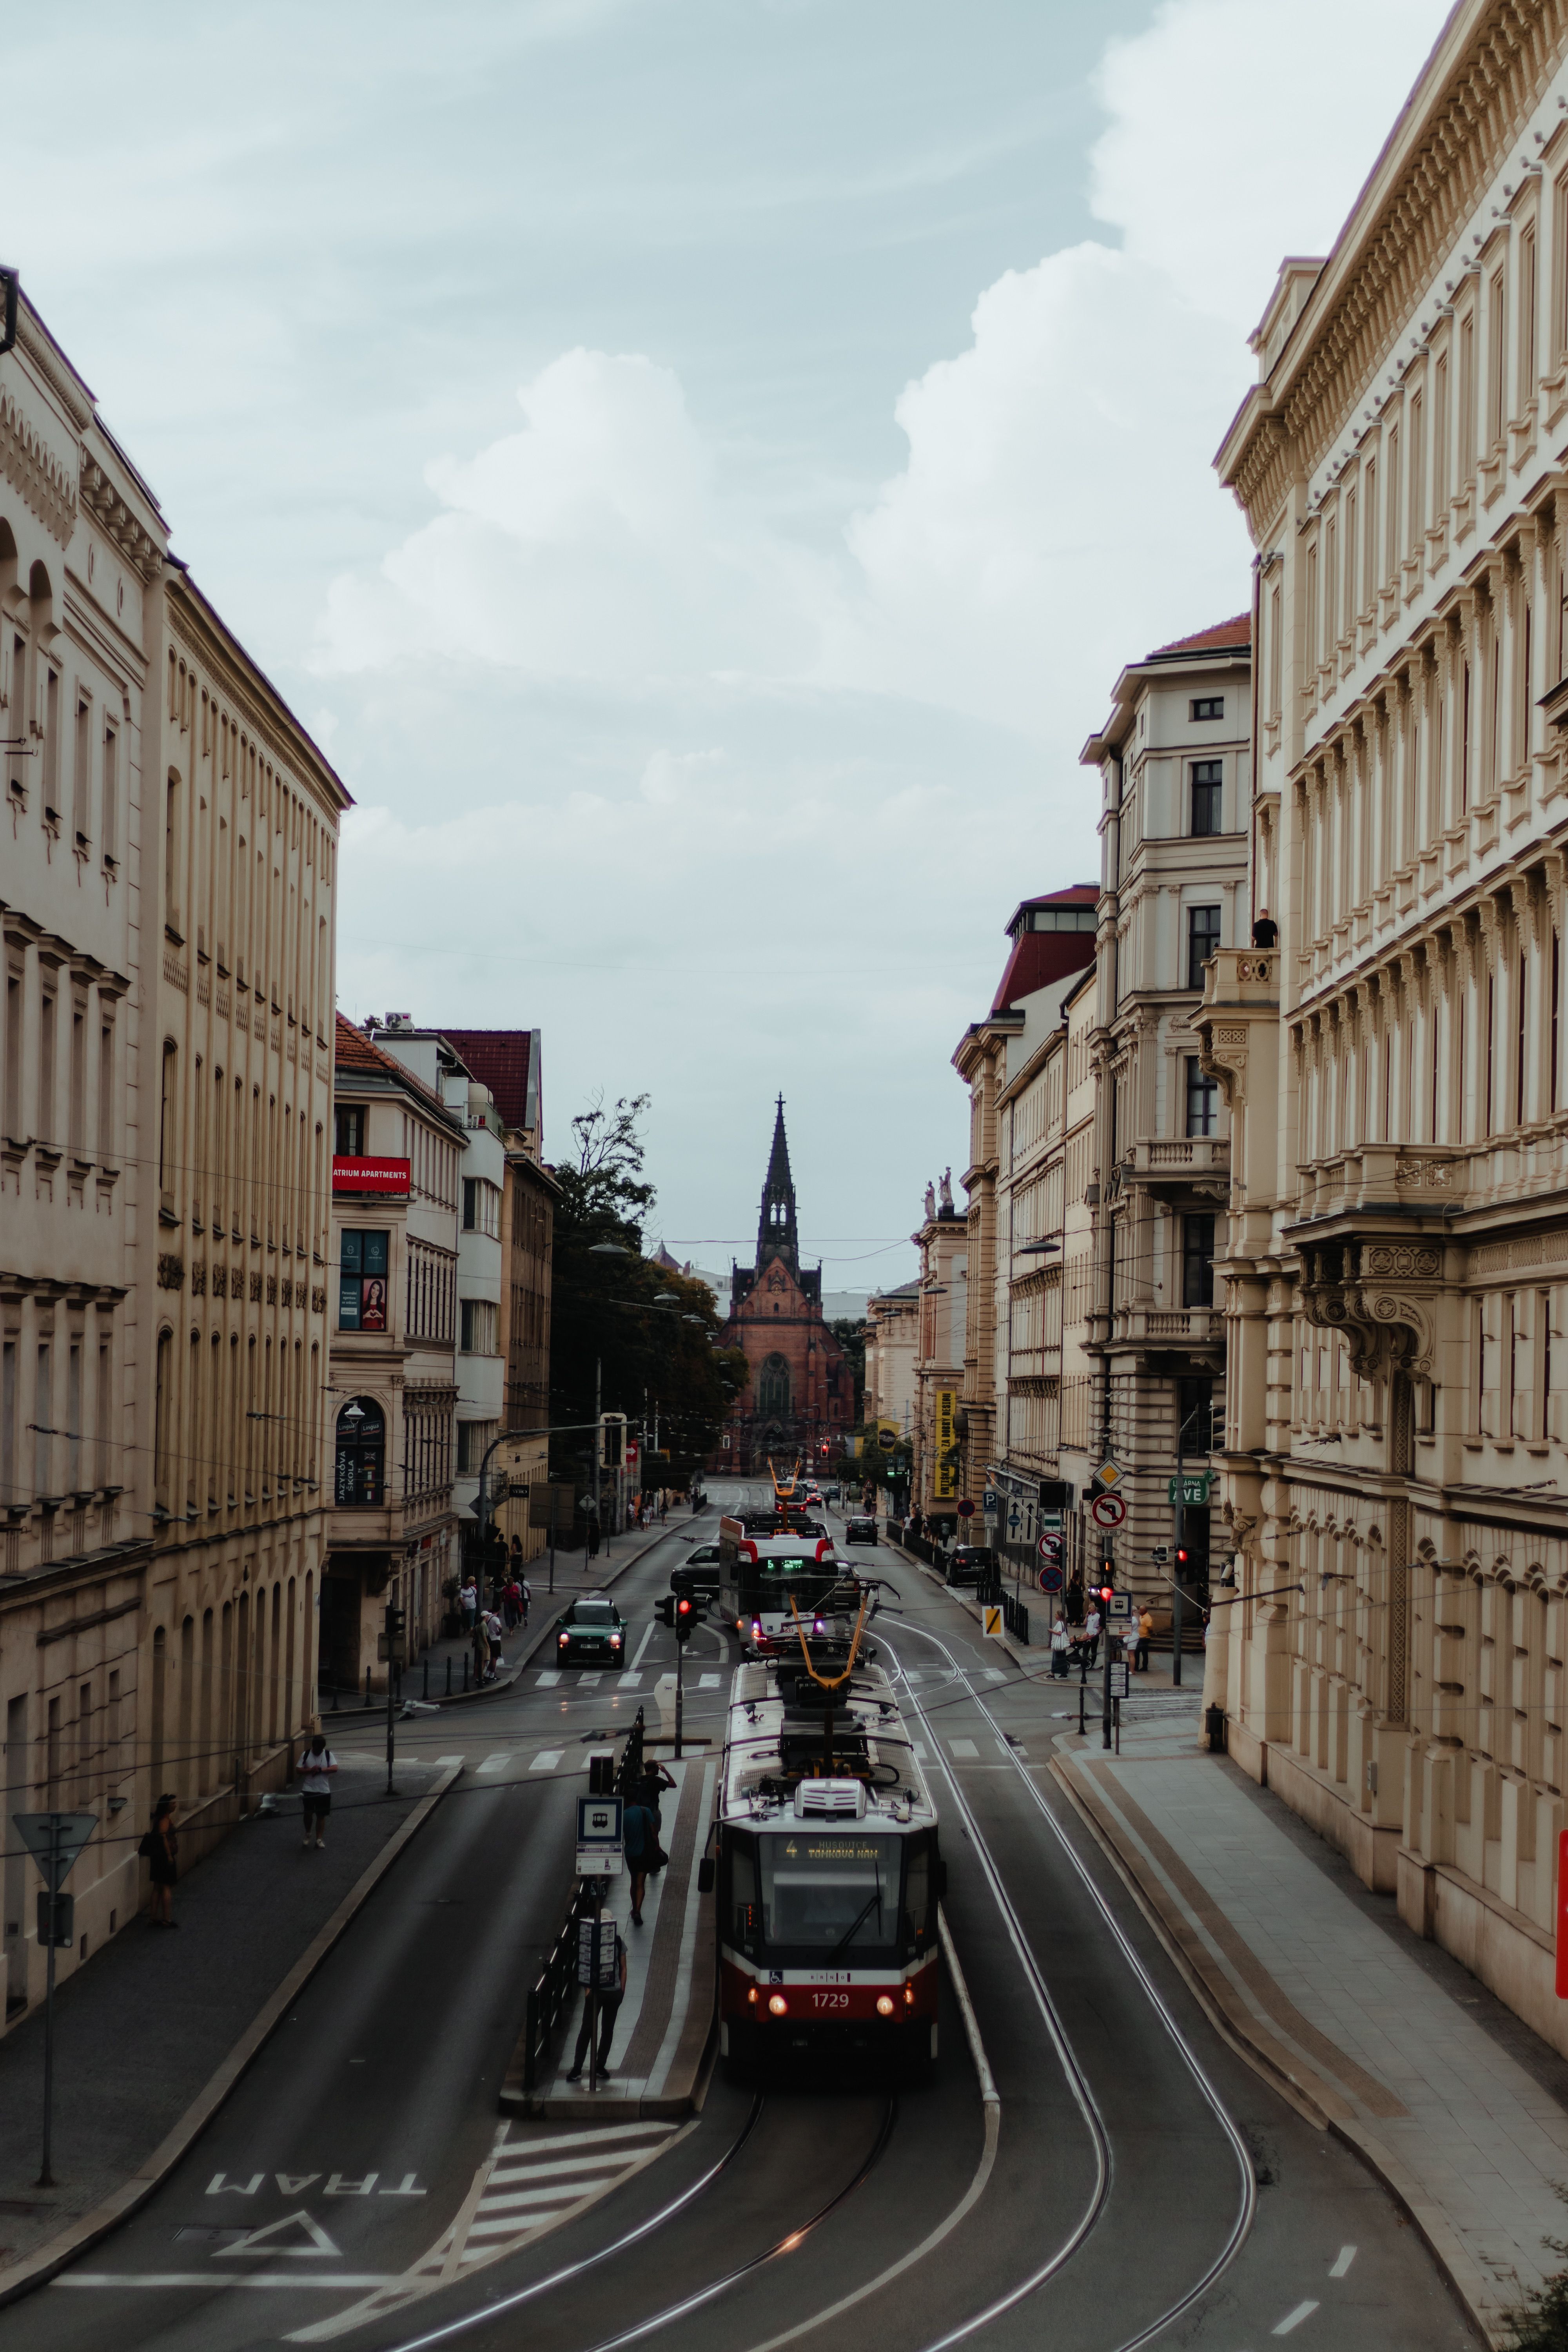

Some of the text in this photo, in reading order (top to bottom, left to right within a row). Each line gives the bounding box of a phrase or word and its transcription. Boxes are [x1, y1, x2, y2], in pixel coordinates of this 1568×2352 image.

[361, 1170, 407, 1179] APARTMENTS
[942, 1393, 951, 1416] DESIGN
[1173, 1479, 1201, 1487] LÁRNA
[986, 1494, 995, 1506] P
[786, 1840, 797, 1858] 4
[808, 1849, 854, 1858] TOMKOVO
[812, 1993, 849, 2007] 1729
[204, 2173, 427, 2194] TRAM
